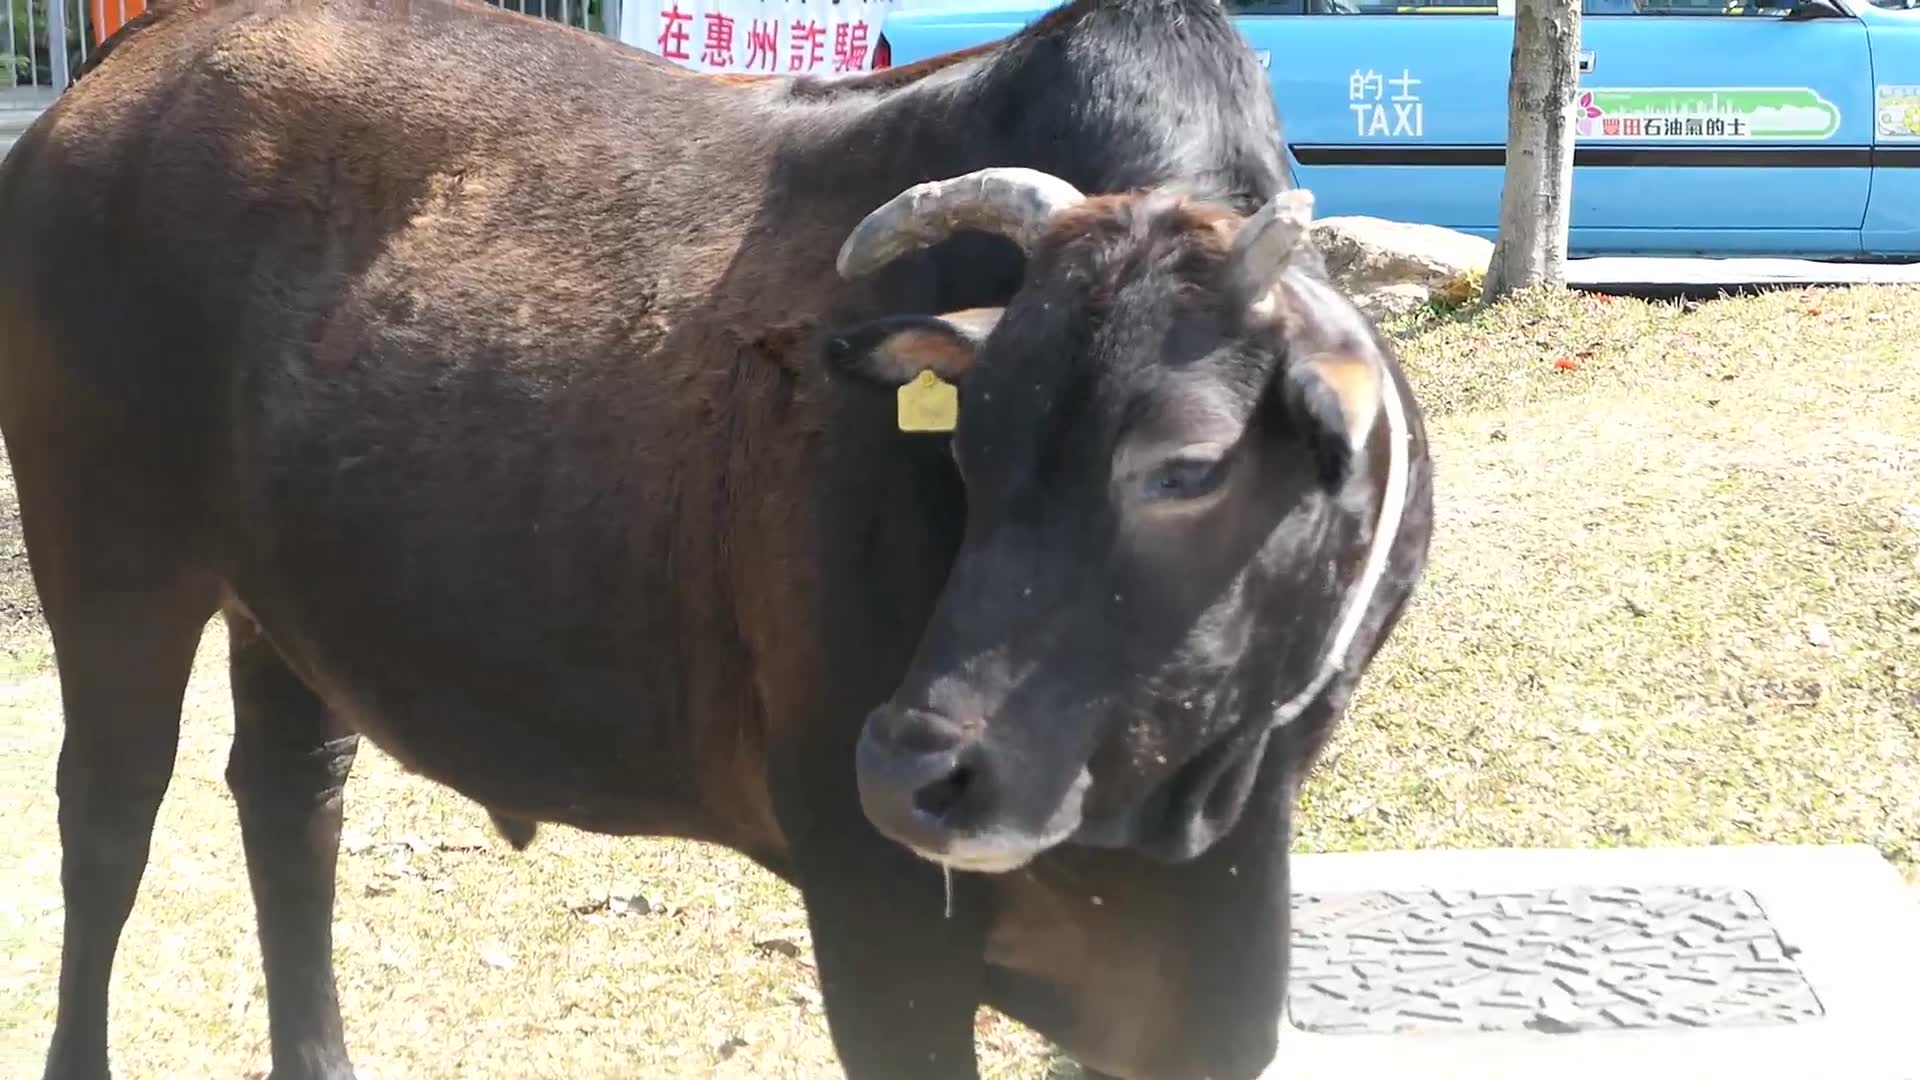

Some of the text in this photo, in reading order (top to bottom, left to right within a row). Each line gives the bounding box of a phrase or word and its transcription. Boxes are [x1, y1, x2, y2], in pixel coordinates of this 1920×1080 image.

[658, 5, 868, 71] 在惠州詐騙
[1349, 68, 1422, 101] 的士
[1349, 103, 1424, 137] TAXI
